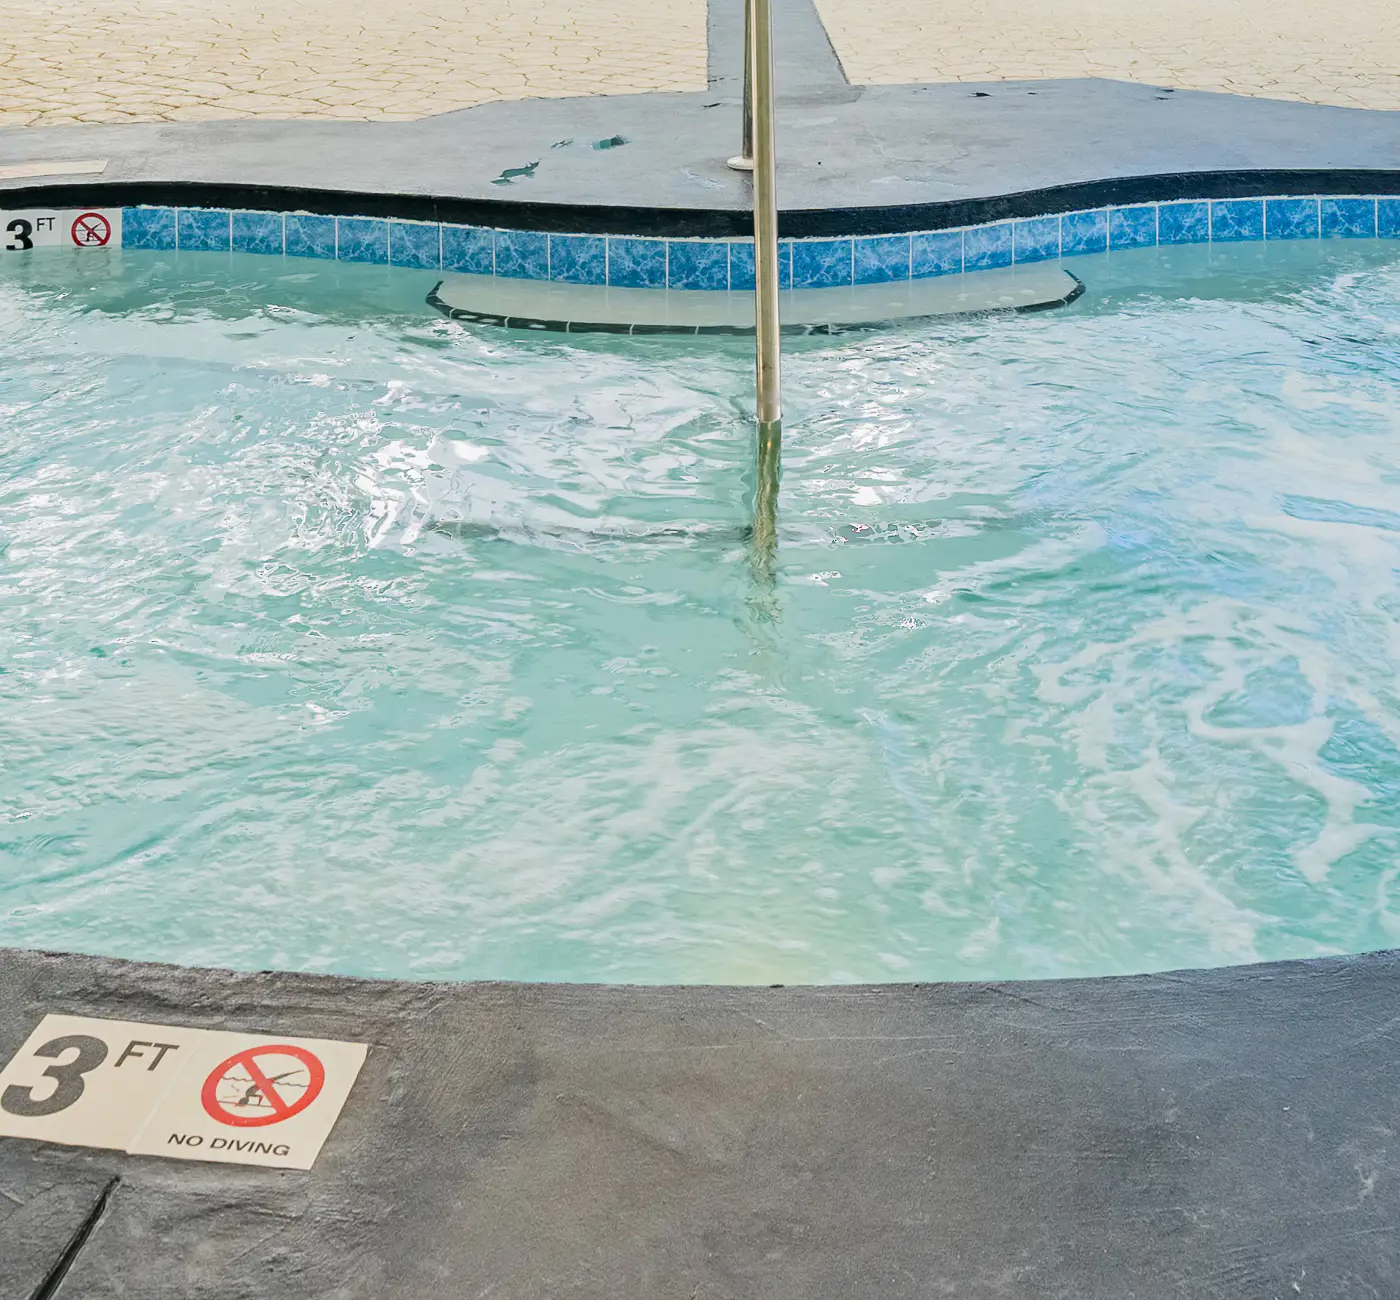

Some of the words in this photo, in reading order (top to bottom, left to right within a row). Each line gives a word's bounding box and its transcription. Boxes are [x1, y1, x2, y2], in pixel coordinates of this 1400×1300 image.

[6, 218, 33, 250] 3
[37, 217, 55, 231] FT
[0, 1035, 109, 1117] 3
[114, 1040, 180, 1071] FT
[167, 1132, 204, 1147] NO
[209, 1137, 290, 1157] DIVING
